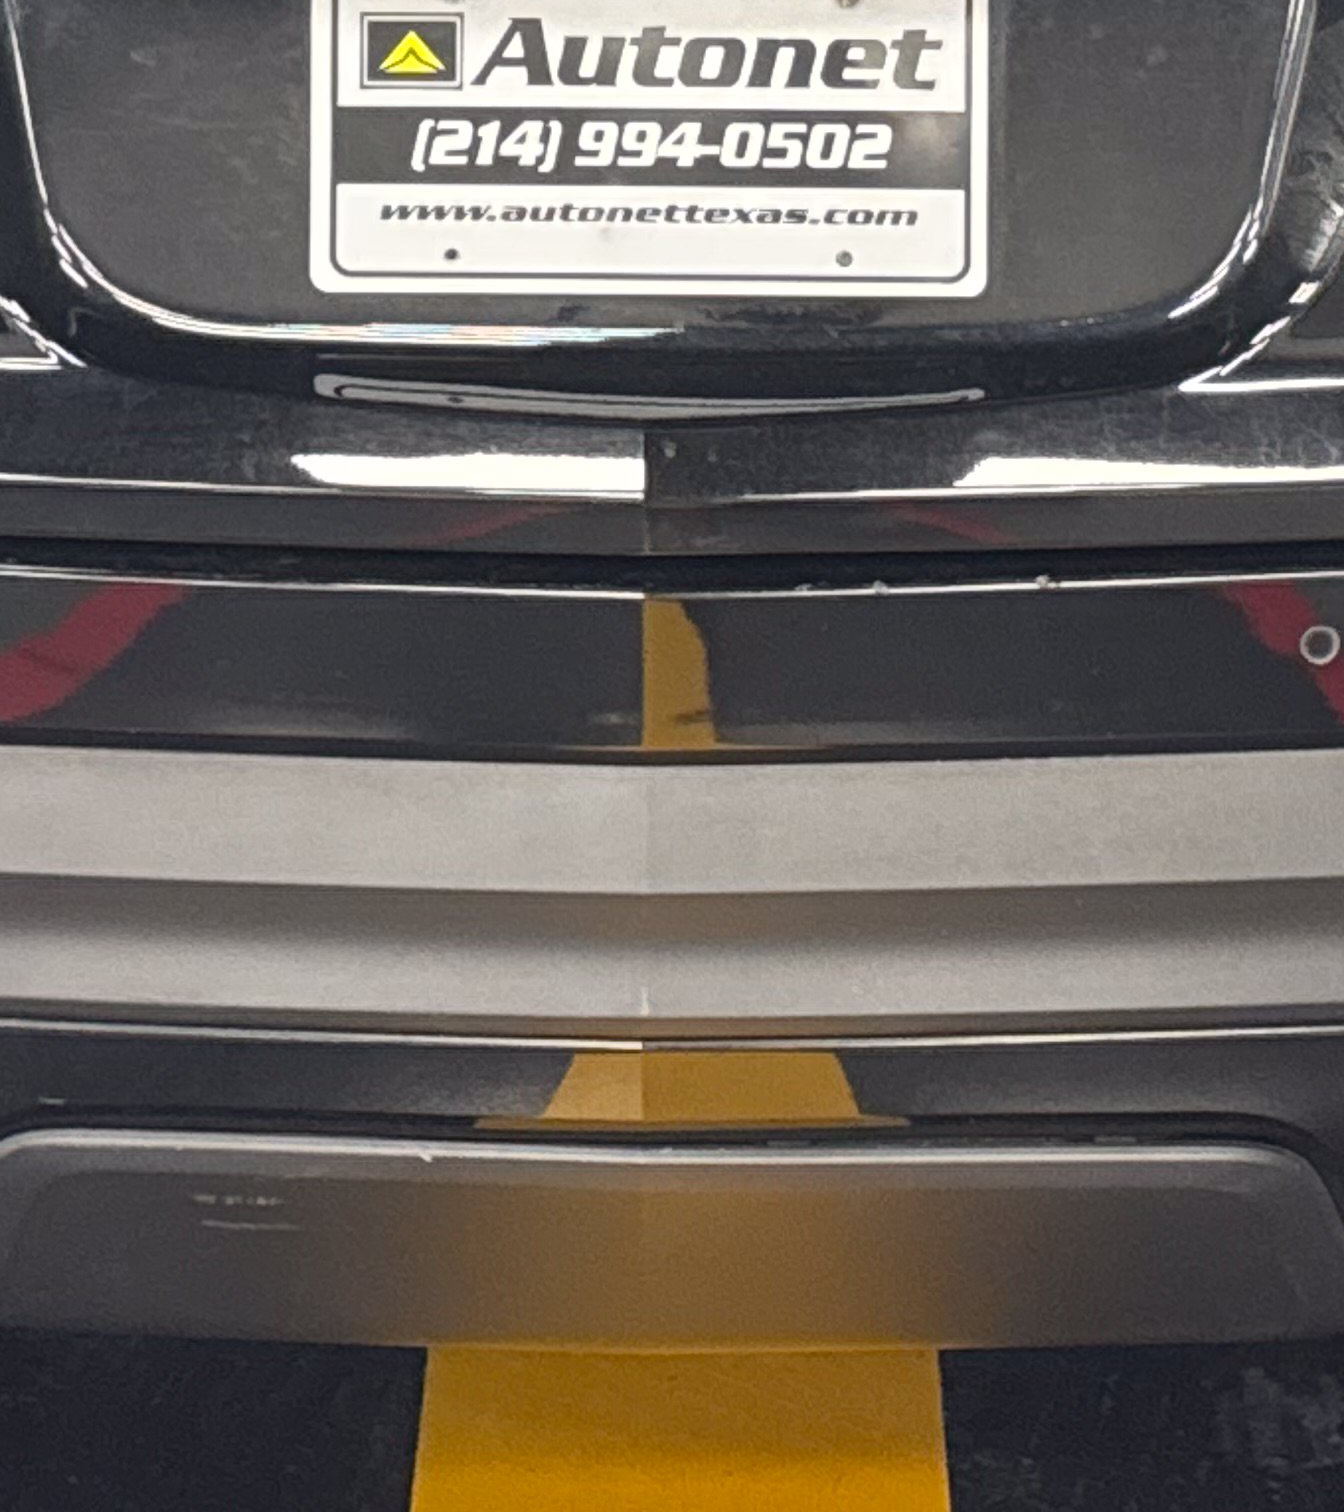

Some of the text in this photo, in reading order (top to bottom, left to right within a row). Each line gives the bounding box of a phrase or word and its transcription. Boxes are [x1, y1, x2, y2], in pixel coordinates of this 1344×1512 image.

[471, 17, 943, 91] Autonet
[411, 119, 893, 172] (214) 994-0502
[379, 201, 919, 227] www.autonettexas.com
